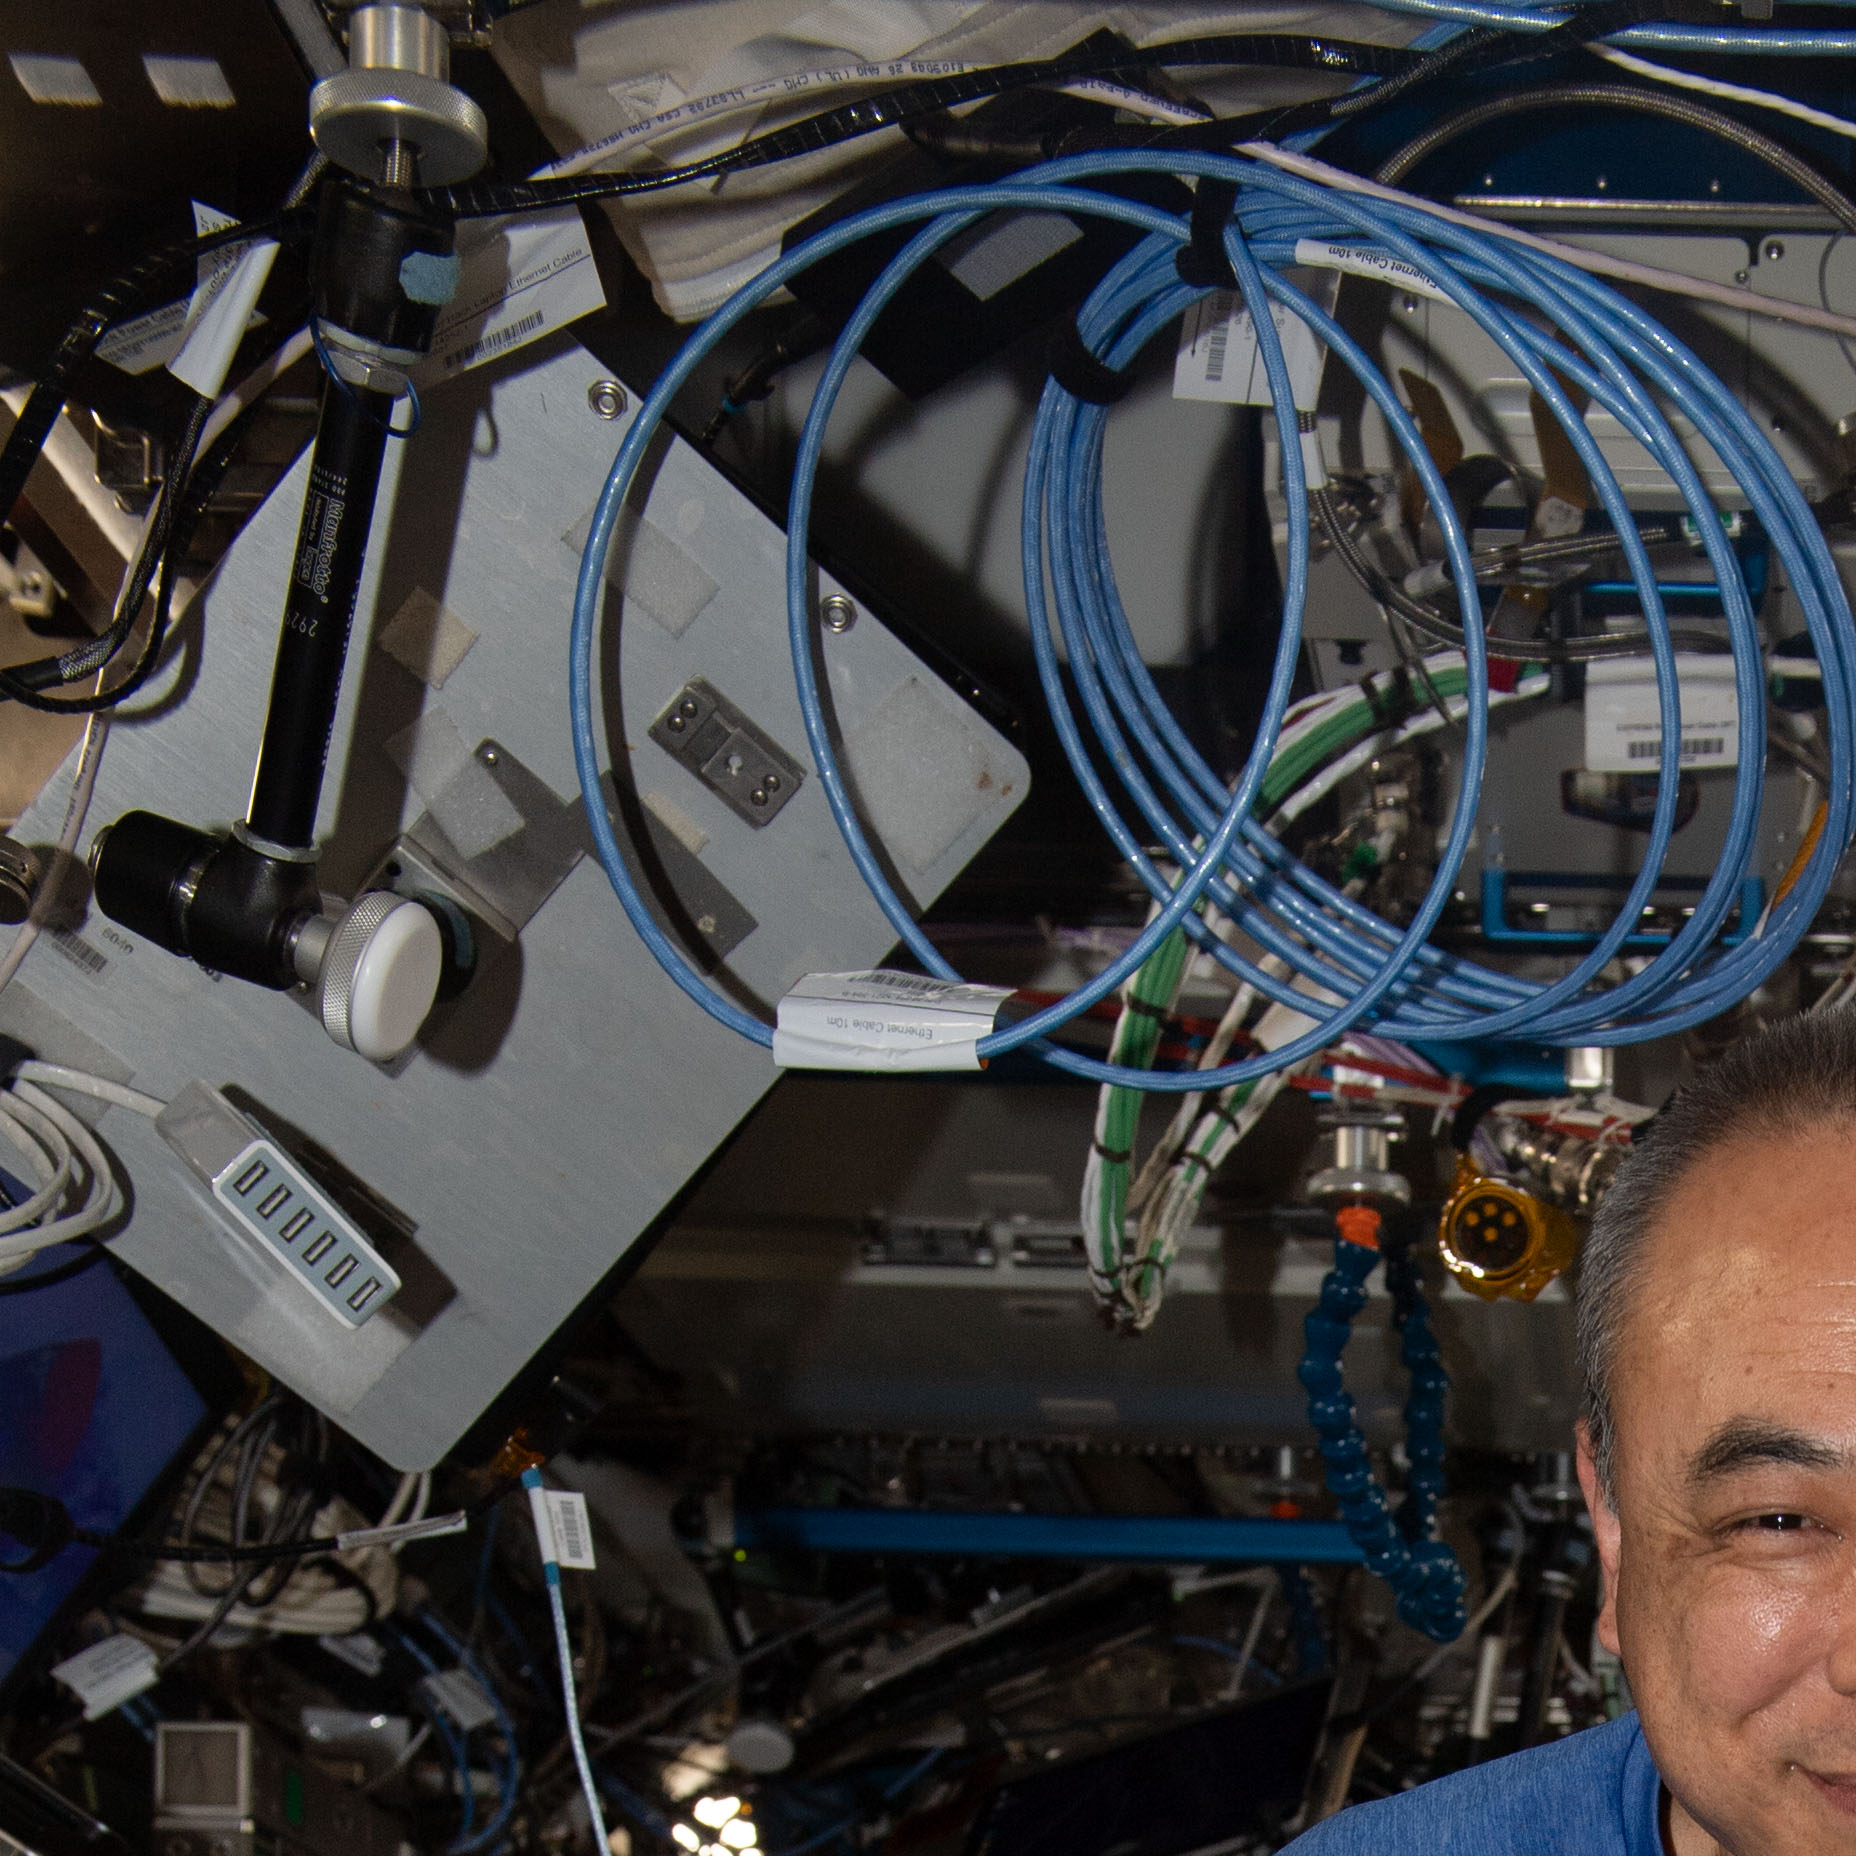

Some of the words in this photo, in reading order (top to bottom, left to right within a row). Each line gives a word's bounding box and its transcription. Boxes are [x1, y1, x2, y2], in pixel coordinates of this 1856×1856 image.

[887, 62, 904, 76] 26
[1328, 245, 1352, 260] 10m
[1354, 250, 1389, 271] Cable
[507, 263, 552, 291] Ethernet
[551, 246, 584, 269] Cable
[313, 498, 345, 596] Manfrotto
[826, 1015, 849, 1029] 10m
[852, 1018, 884, 1034] Cable
[886, 1022, 934, 1040] Ethernet
